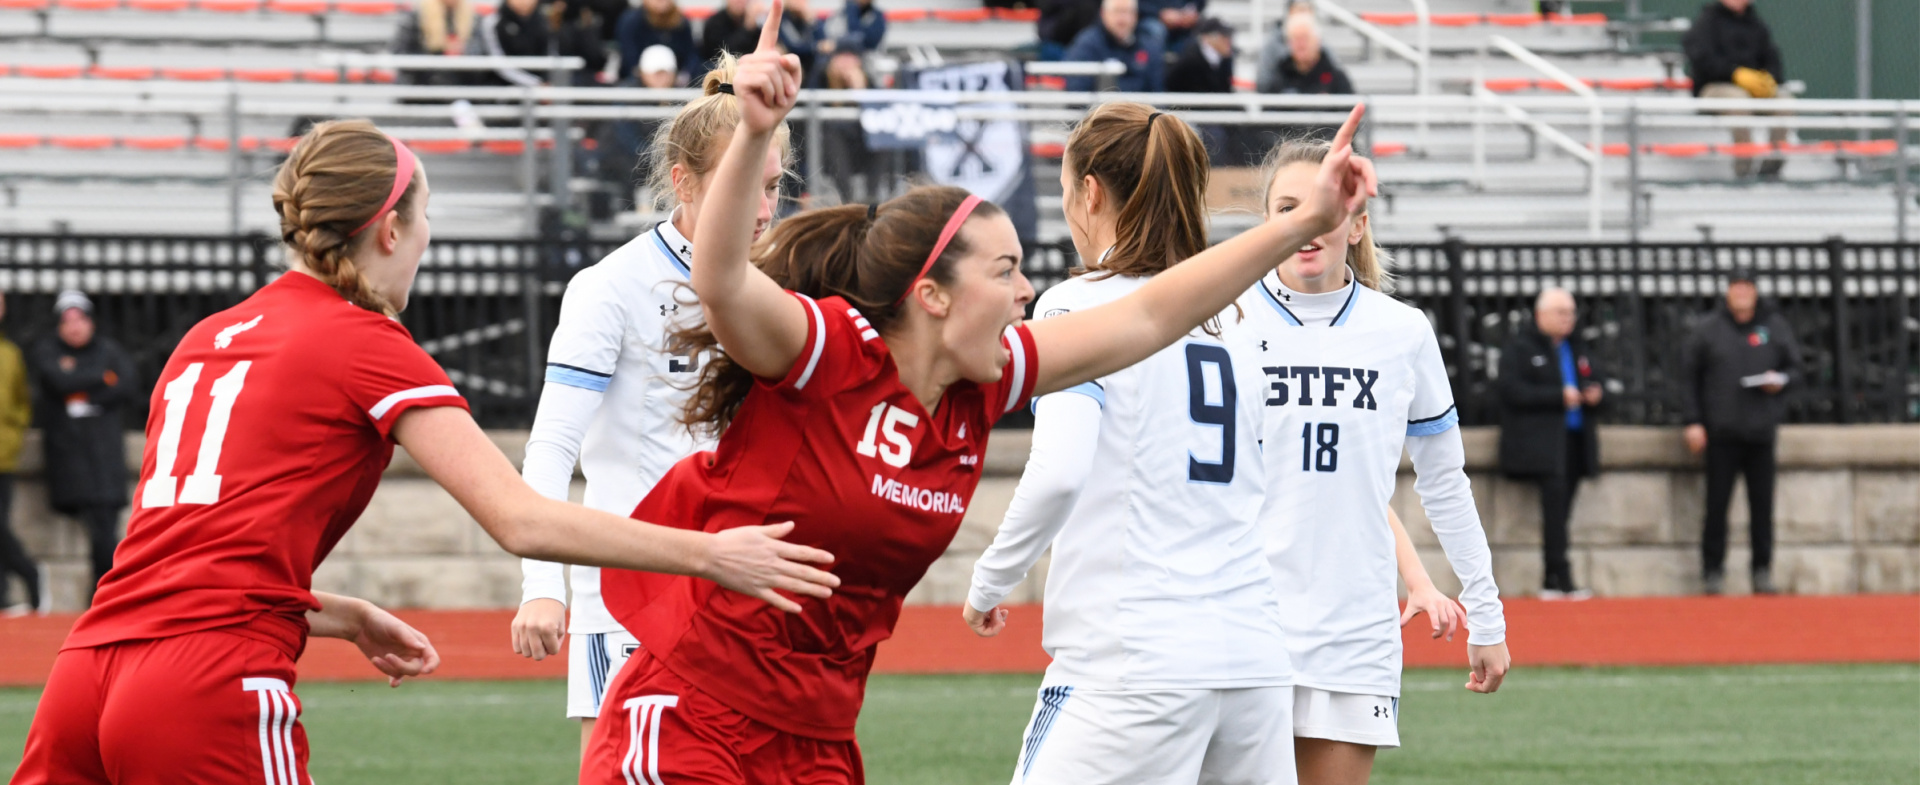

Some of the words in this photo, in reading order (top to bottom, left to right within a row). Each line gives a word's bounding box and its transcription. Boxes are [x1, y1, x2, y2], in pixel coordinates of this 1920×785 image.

[1184, 341, 1238, 486] 9
[1262, 365, 1379, 411] STFX
[141, 360, 253, 509] 11
[856, 401, 919, 468] 15
[1301, 421, 1339, 472] 18
[871, 473, 964, 514] MEMORIAL
